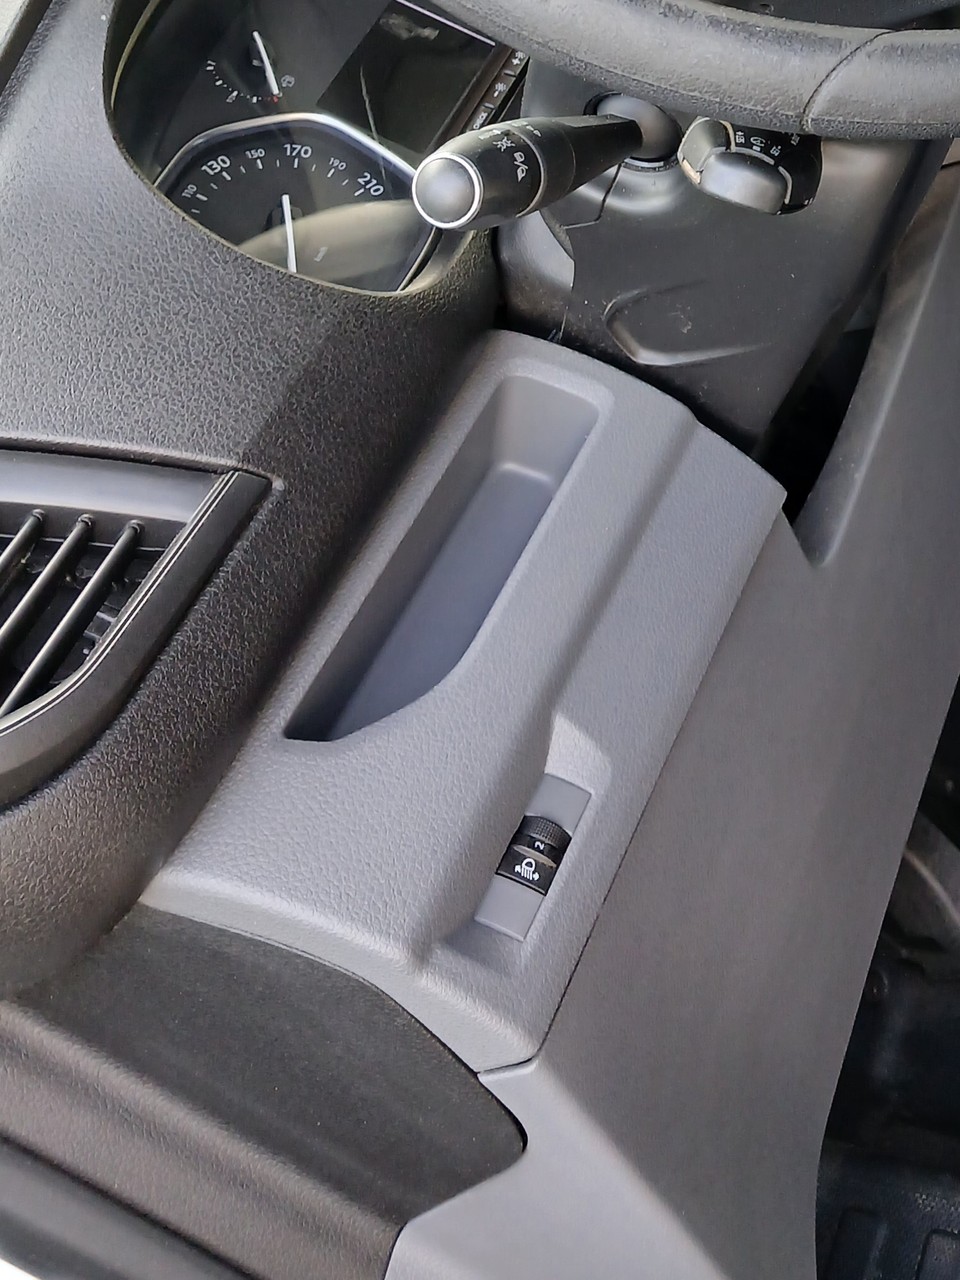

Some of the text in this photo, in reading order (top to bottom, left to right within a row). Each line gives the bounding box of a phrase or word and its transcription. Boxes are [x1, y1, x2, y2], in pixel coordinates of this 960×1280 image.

[245, 148, 266, 159] 150
[284, 143, 312, 159] 170
[201, 154, 231, 175] 130
[329, 157, 347, 171] 190
[357, 172, 385, 197] 210
[534, 841, 545, 850] 2
